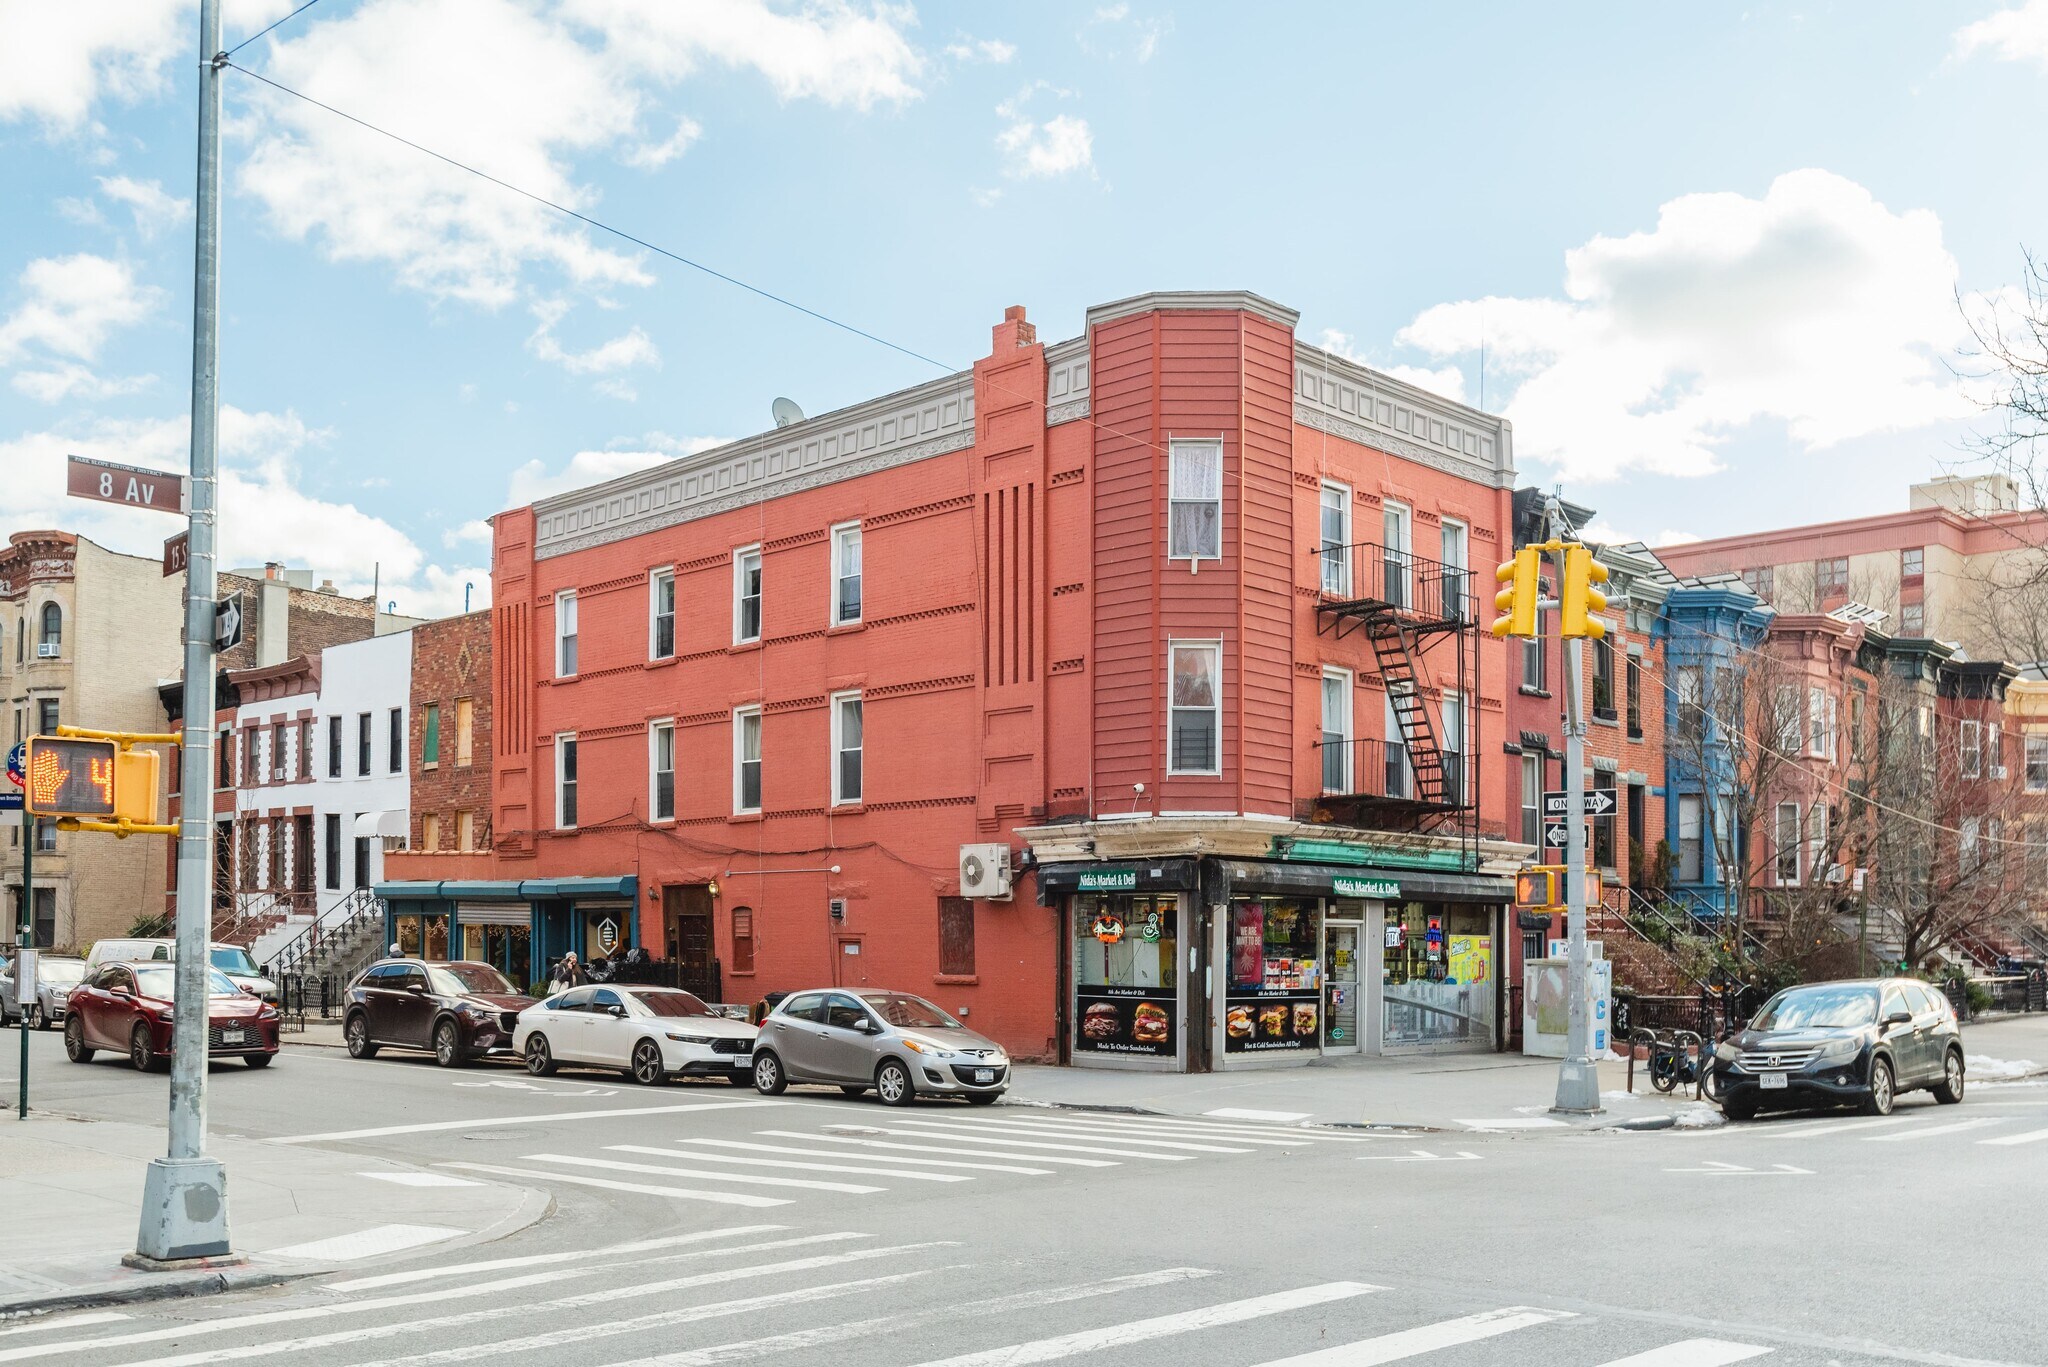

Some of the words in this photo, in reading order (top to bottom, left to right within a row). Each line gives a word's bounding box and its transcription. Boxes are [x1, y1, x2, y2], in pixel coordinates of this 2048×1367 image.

[75, 457, 90, 465] PARK
[91, 459, 109, 468] SLOPE
[110, 463, 136, 473] HISTORIC
[137, 467, 162, 477] DISTRICT
[100, 472, 113, 498] 8
[125, 477, 154, 504] Av
[171, 545, 179, 569] 15
[182, 542, 188, 566] S
[91, 758, 112, 804] 4
[1554, 799, 1567, 809] ON
[1584, 798, 1605, 807] WAY
[1552, 830, 1564, 841] ONE
[1080, 874, 1096, 887] Nida's
[1097, 874, 1117, 887] Market
[1118, 875, 1123, 885] &
[1123, 873, 1135, 885] Deli
[1334, 880, 1354, 892] Nida's
[1355, 881, 1378, 893] Market
[1379, 882, 1385, 894] &
[1385, 883, 1399, 894] Deli
[1240, 926, 1248, 936] WE
[1248, 926, 1257, 936] ARE
[1255, 936, 1261, 945] BE
[1129, 1044, 1156, 1052] Sandwiches!
